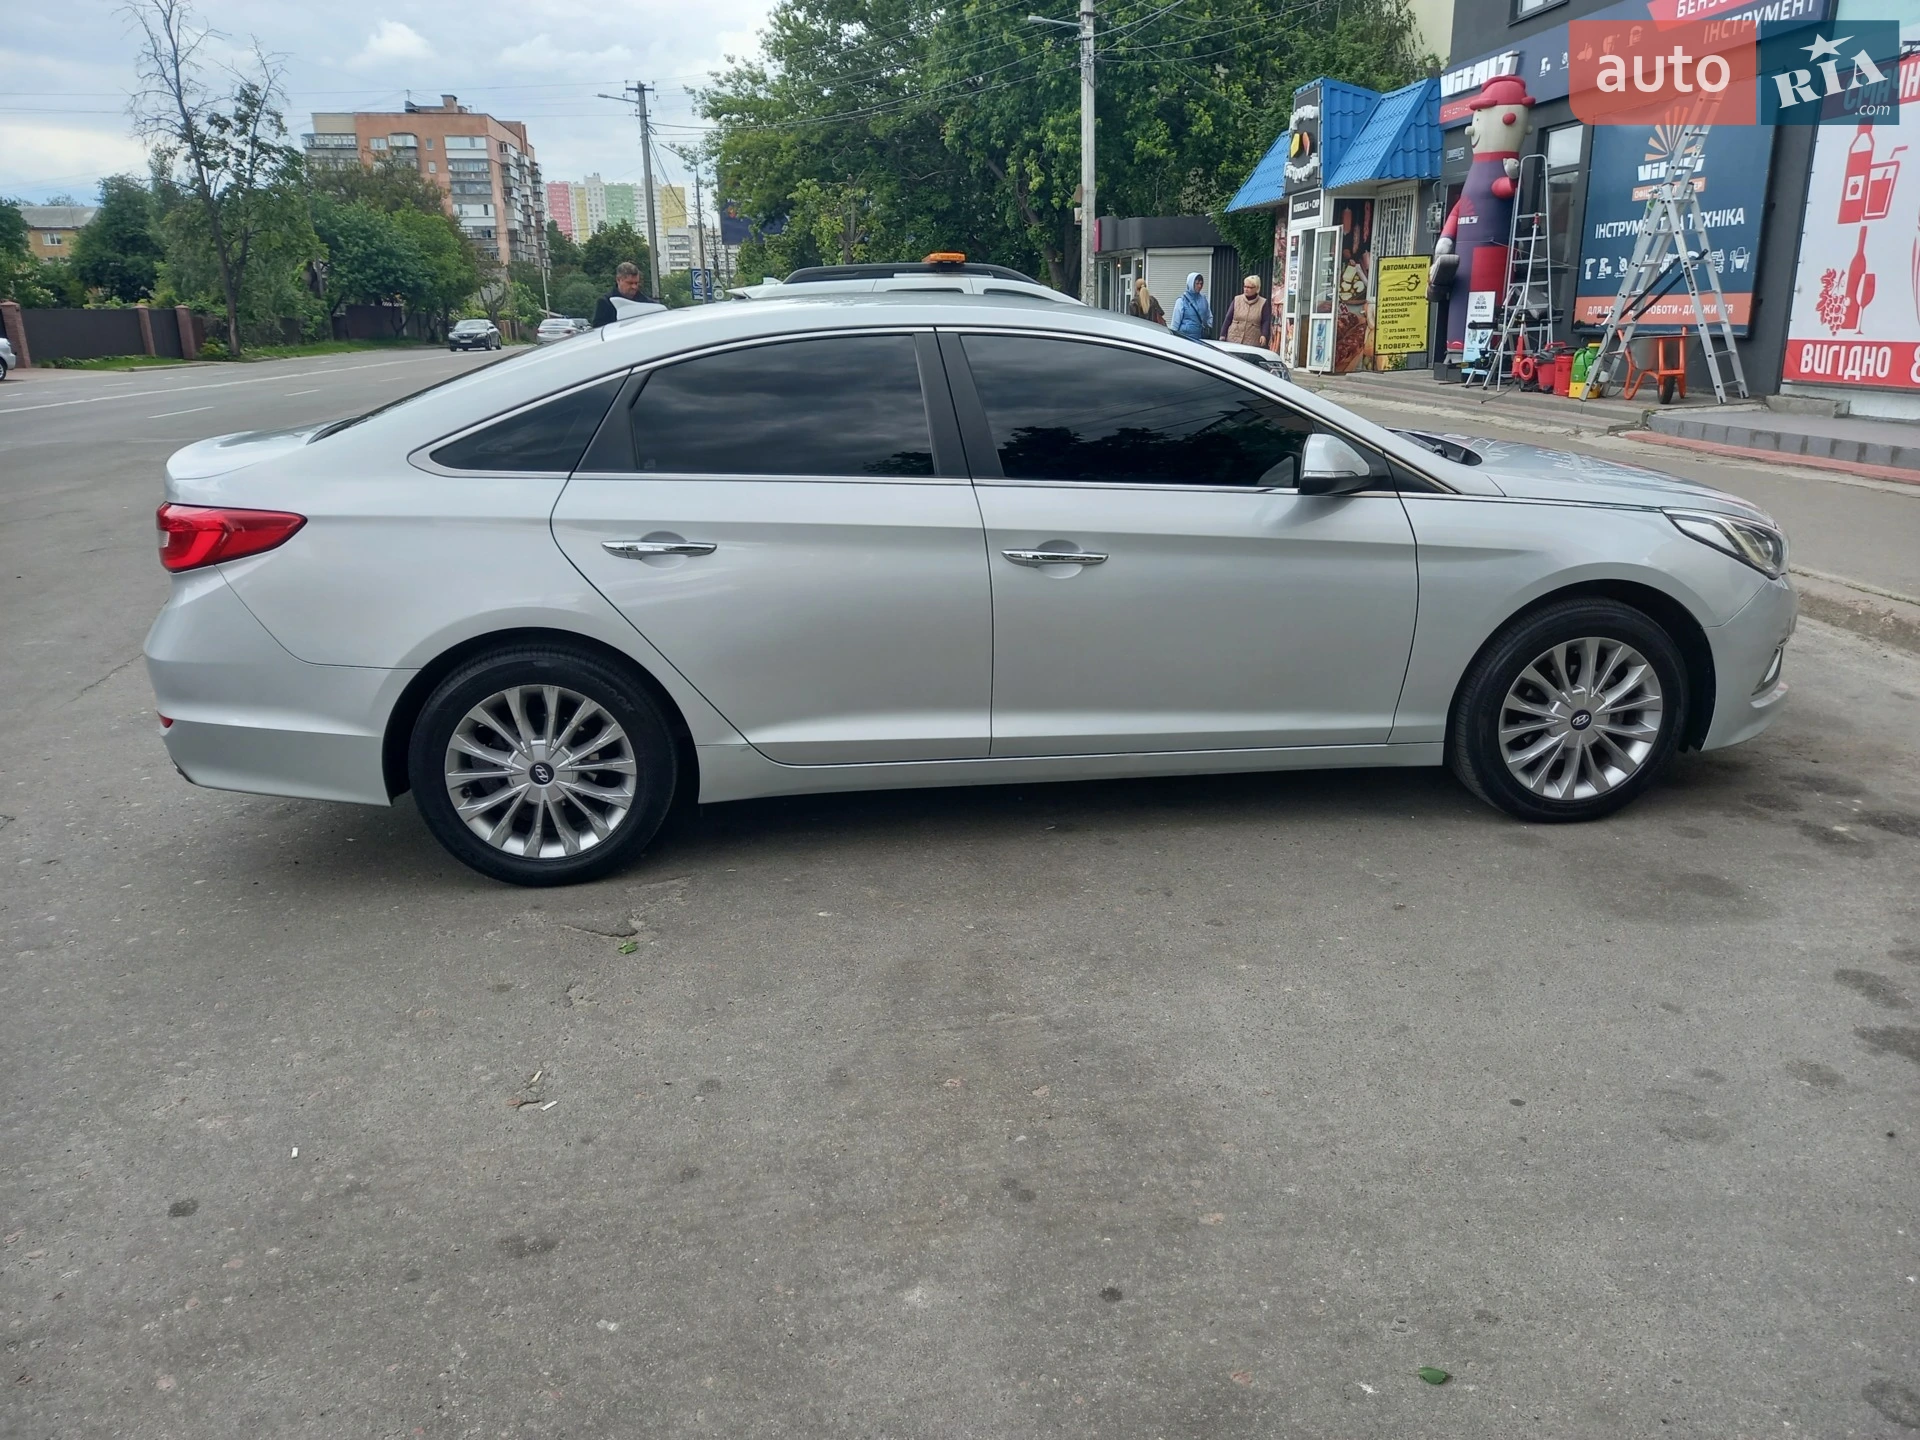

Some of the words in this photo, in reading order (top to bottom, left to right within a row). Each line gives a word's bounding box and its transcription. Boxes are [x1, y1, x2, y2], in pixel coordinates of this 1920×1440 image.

[1595, 216, 1666, 239] ІНСТРУМТ
[1686, 207, 1745, 230] ТХНІКА
[1382, 263, 1427, 271] АВТОМАГАЗИН
[1586, 305, 1602, 316] ДЛЯ
[1682, 304, 1695, 316] ДЛ
[1702, 304, 1734, 315] ЖИЯ
[1383, 342, 1411, 350] ПОВЕРХ
[1800, 343, 1892, 381] ВИГІДНО
